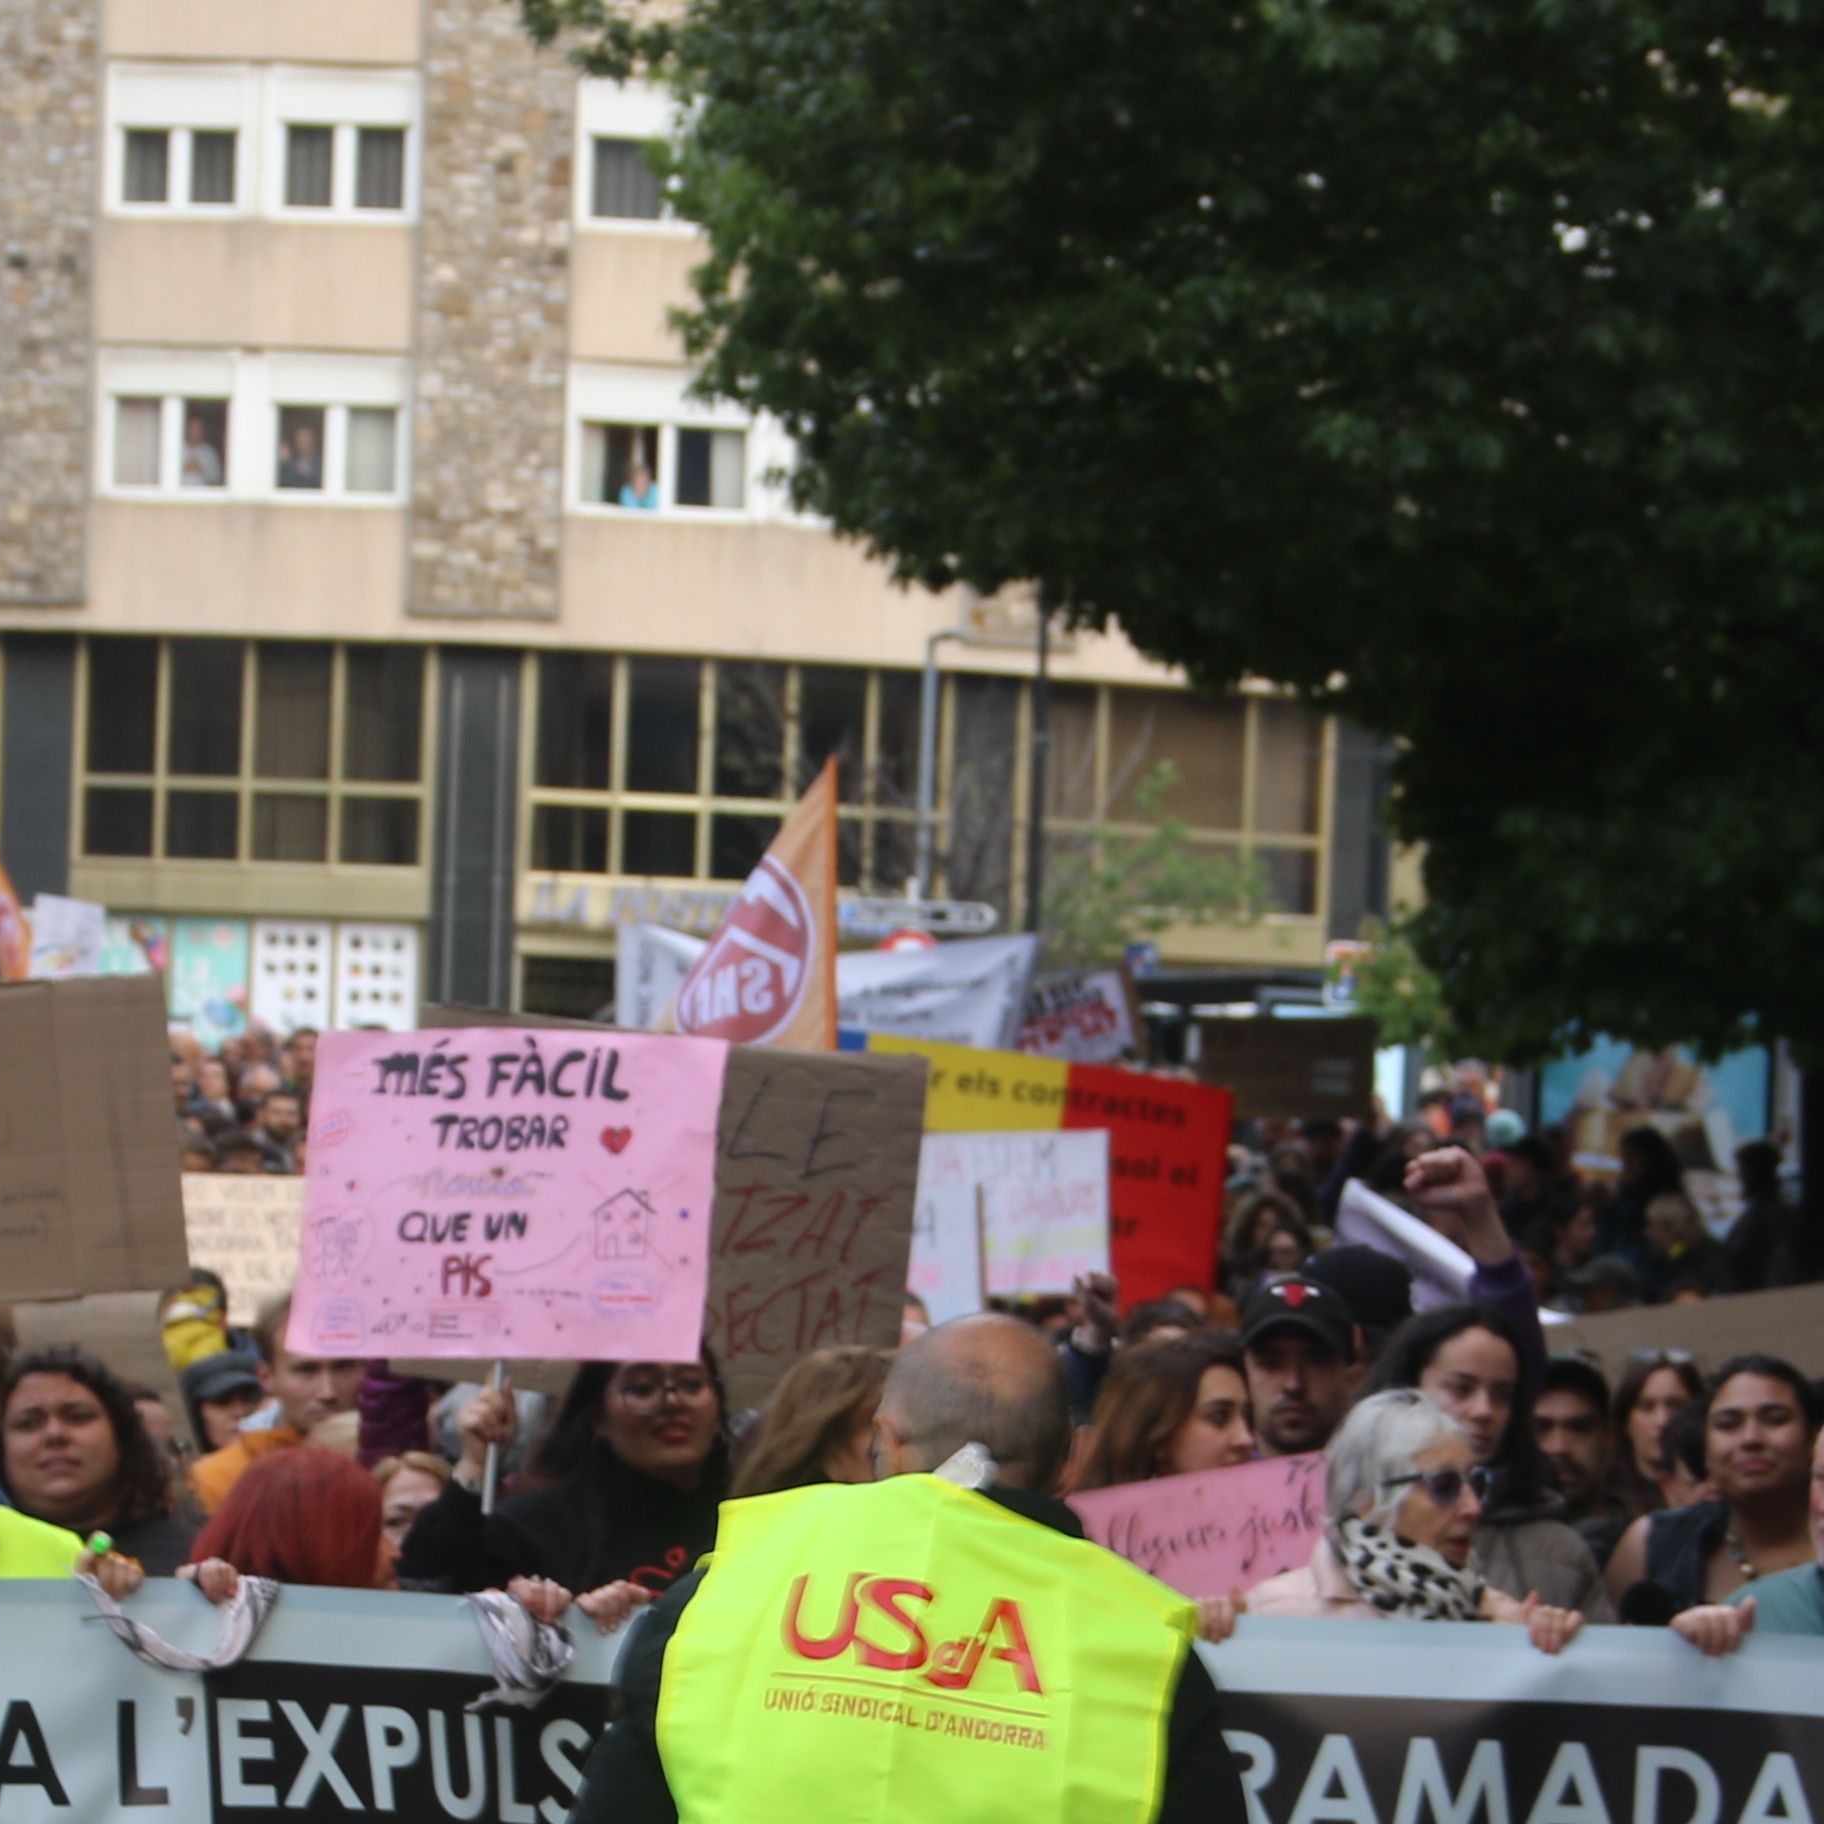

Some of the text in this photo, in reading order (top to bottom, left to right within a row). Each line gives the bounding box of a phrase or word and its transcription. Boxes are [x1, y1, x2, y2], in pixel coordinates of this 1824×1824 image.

[956, 1067, 1002, 1099] els
[1012, 1080, 1188, 1128] contractes
[432, 1112, 571, 1152] TROBAR
[397, 1210, 529, 1245] QUE UN
[707, 1262, 898, 1360] ECTAT
[763, 1685, 1048, 1750] UNIÓ SINDICAL D'ANDORRA
